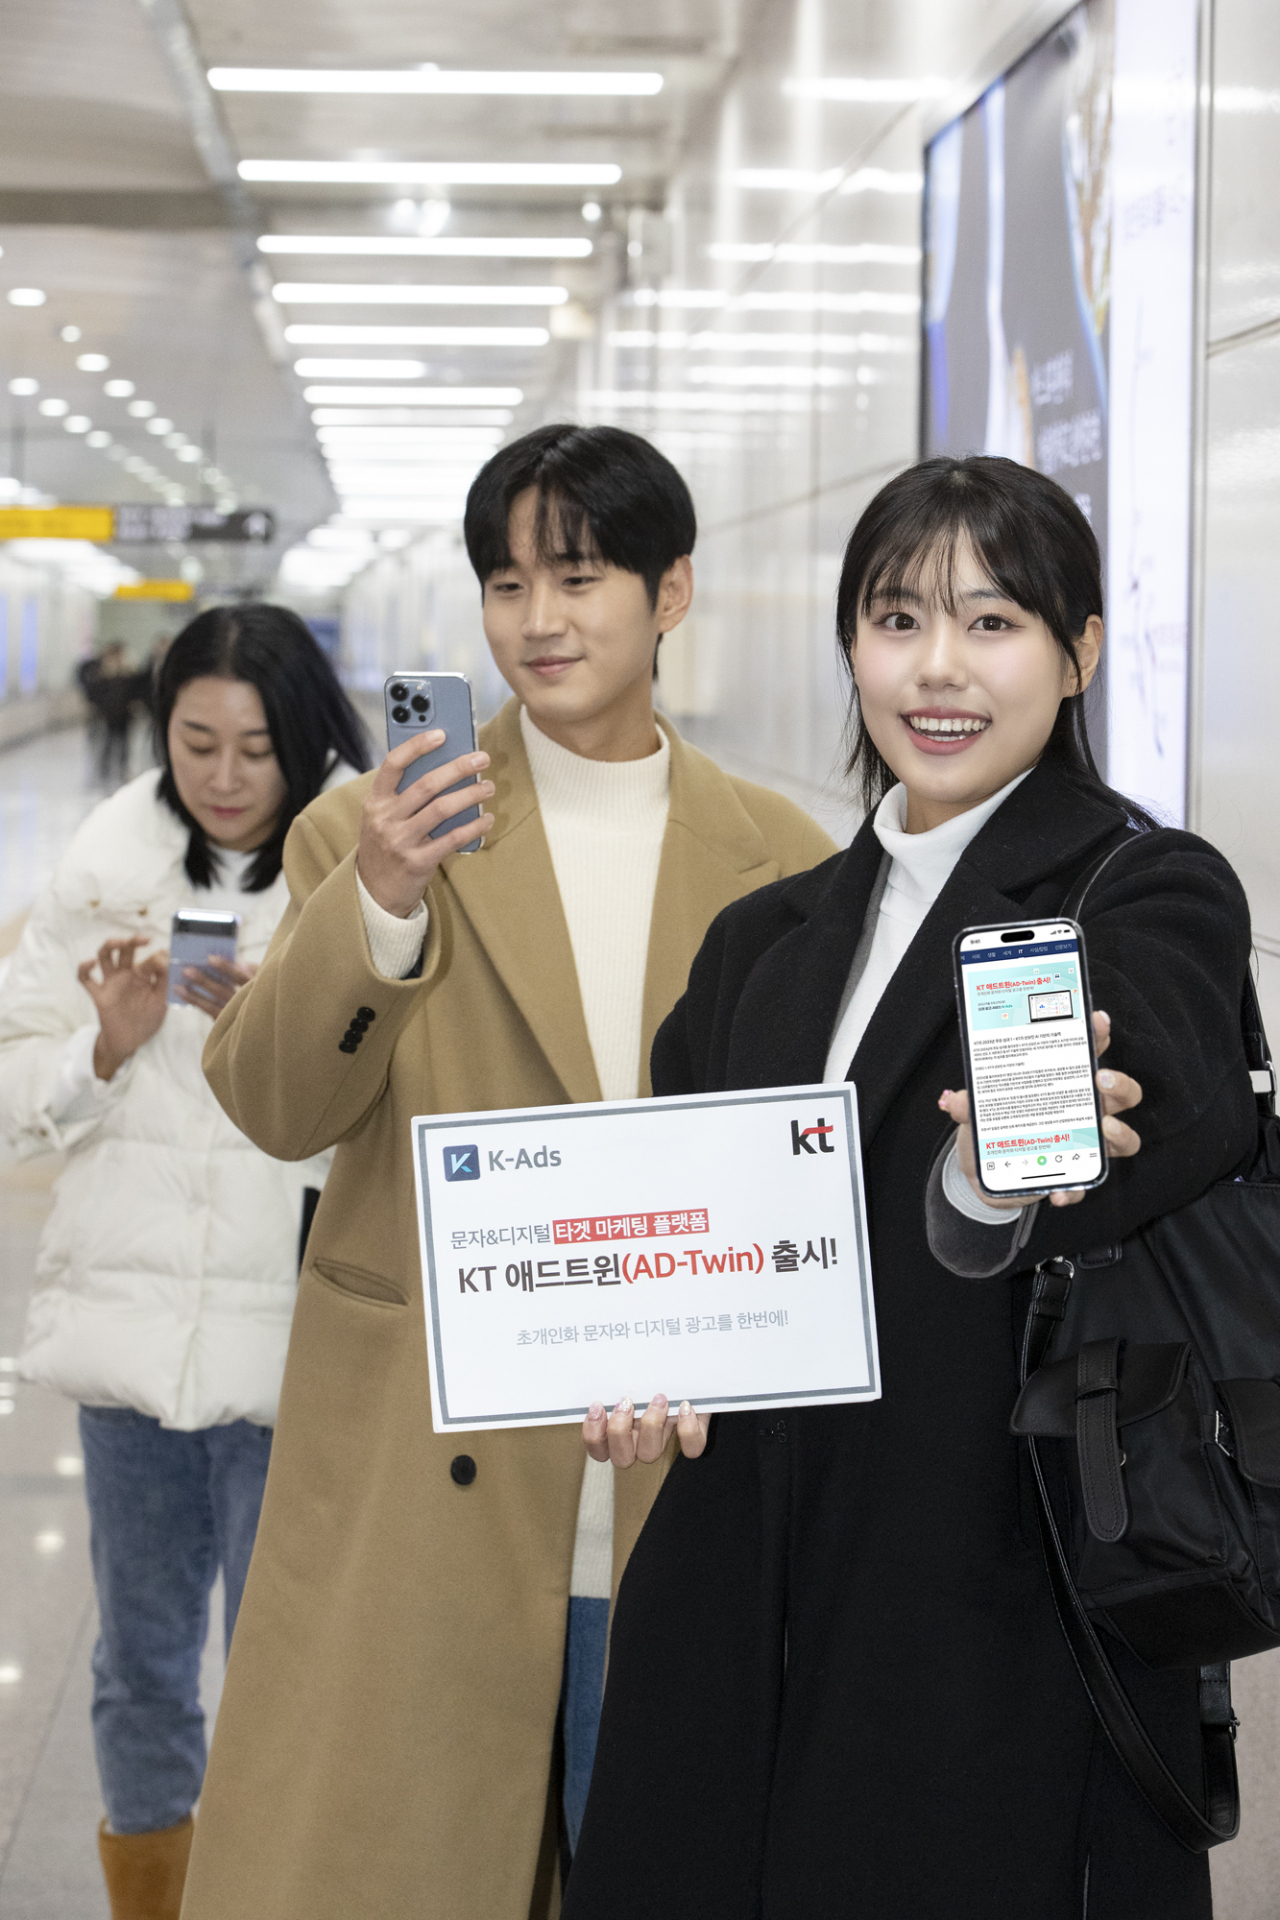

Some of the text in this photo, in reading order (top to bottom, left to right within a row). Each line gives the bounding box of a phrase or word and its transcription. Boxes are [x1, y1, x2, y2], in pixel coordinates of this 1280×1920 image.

[1037, 977, 1051, 985] 출시!
[790, 1117, 835, 1156] kt
[996, 1136, 1053, 1149] 애드트윈(AD-Twin)
[1054, 1134, 1070, 1143] 출시!
[488, 1146, 562, 1171] K-Ads
[450, 1211, 708, 1250] 문자&디지털 타겟 마케팅 플랫폼
[458, 1237, 838, 1294] KT 애드트윈(AD-Twin) 출시!
[516, 1309, 789, 1347] 초개인화 문자와 디지털 광고를 한번에!
